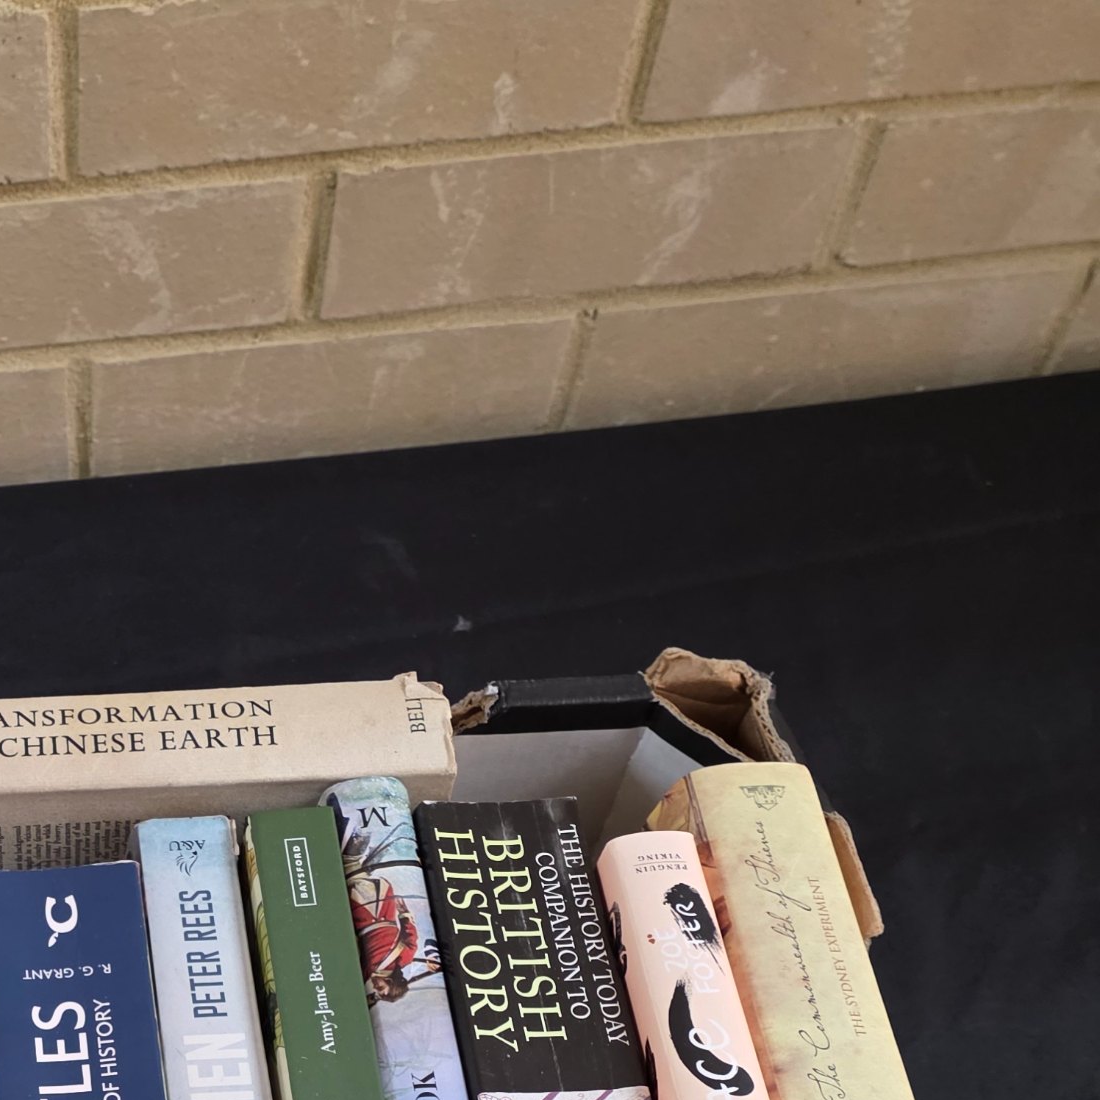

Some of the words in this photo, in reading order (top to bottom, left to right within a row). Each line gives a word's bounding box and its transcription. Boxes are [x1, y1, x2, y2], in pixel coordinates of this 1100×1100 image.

[159, 725, 279, 752] EARTH
[356, 806, 391, 829] M
[292, 845, 309, 899] BATSFORD
[557, 824, 585, 869] THE
[635, 863, 688, 875] PENGUIN
[637, 852, 682, 862] VIKING
[744, 820, 781, 886] Thieves
[178, 889, 218, 941] REES
[433, 827, 520, 1053] HISTORY
[481, 834, 568, 1042] BRITISH
[535, 852, 583, 982] COMPANION
[565, 987, 591, 1020] TO
[567, 873, 610, 966] HISTORY
[808, 877, 842, 954] EXPERIMENT
[22, 967, 74, 980] GRANT
[78, 965, 94, 977] G.
[98, 963, 112, 974] R.
[186, 951, 228, 1019] PETER
[308, 951, 325, 982] Beer
[766, 911, 831, 1058] Commonwealth
[834, 957, 860, 1007] SYDNEY
[313, 985, 338, 1055] Amy-Jane
[591, 969, 630, 1046] TODAY
[848, 1011, 867, 1037] THE
[93, 999, 118, 1077] HISTORY
